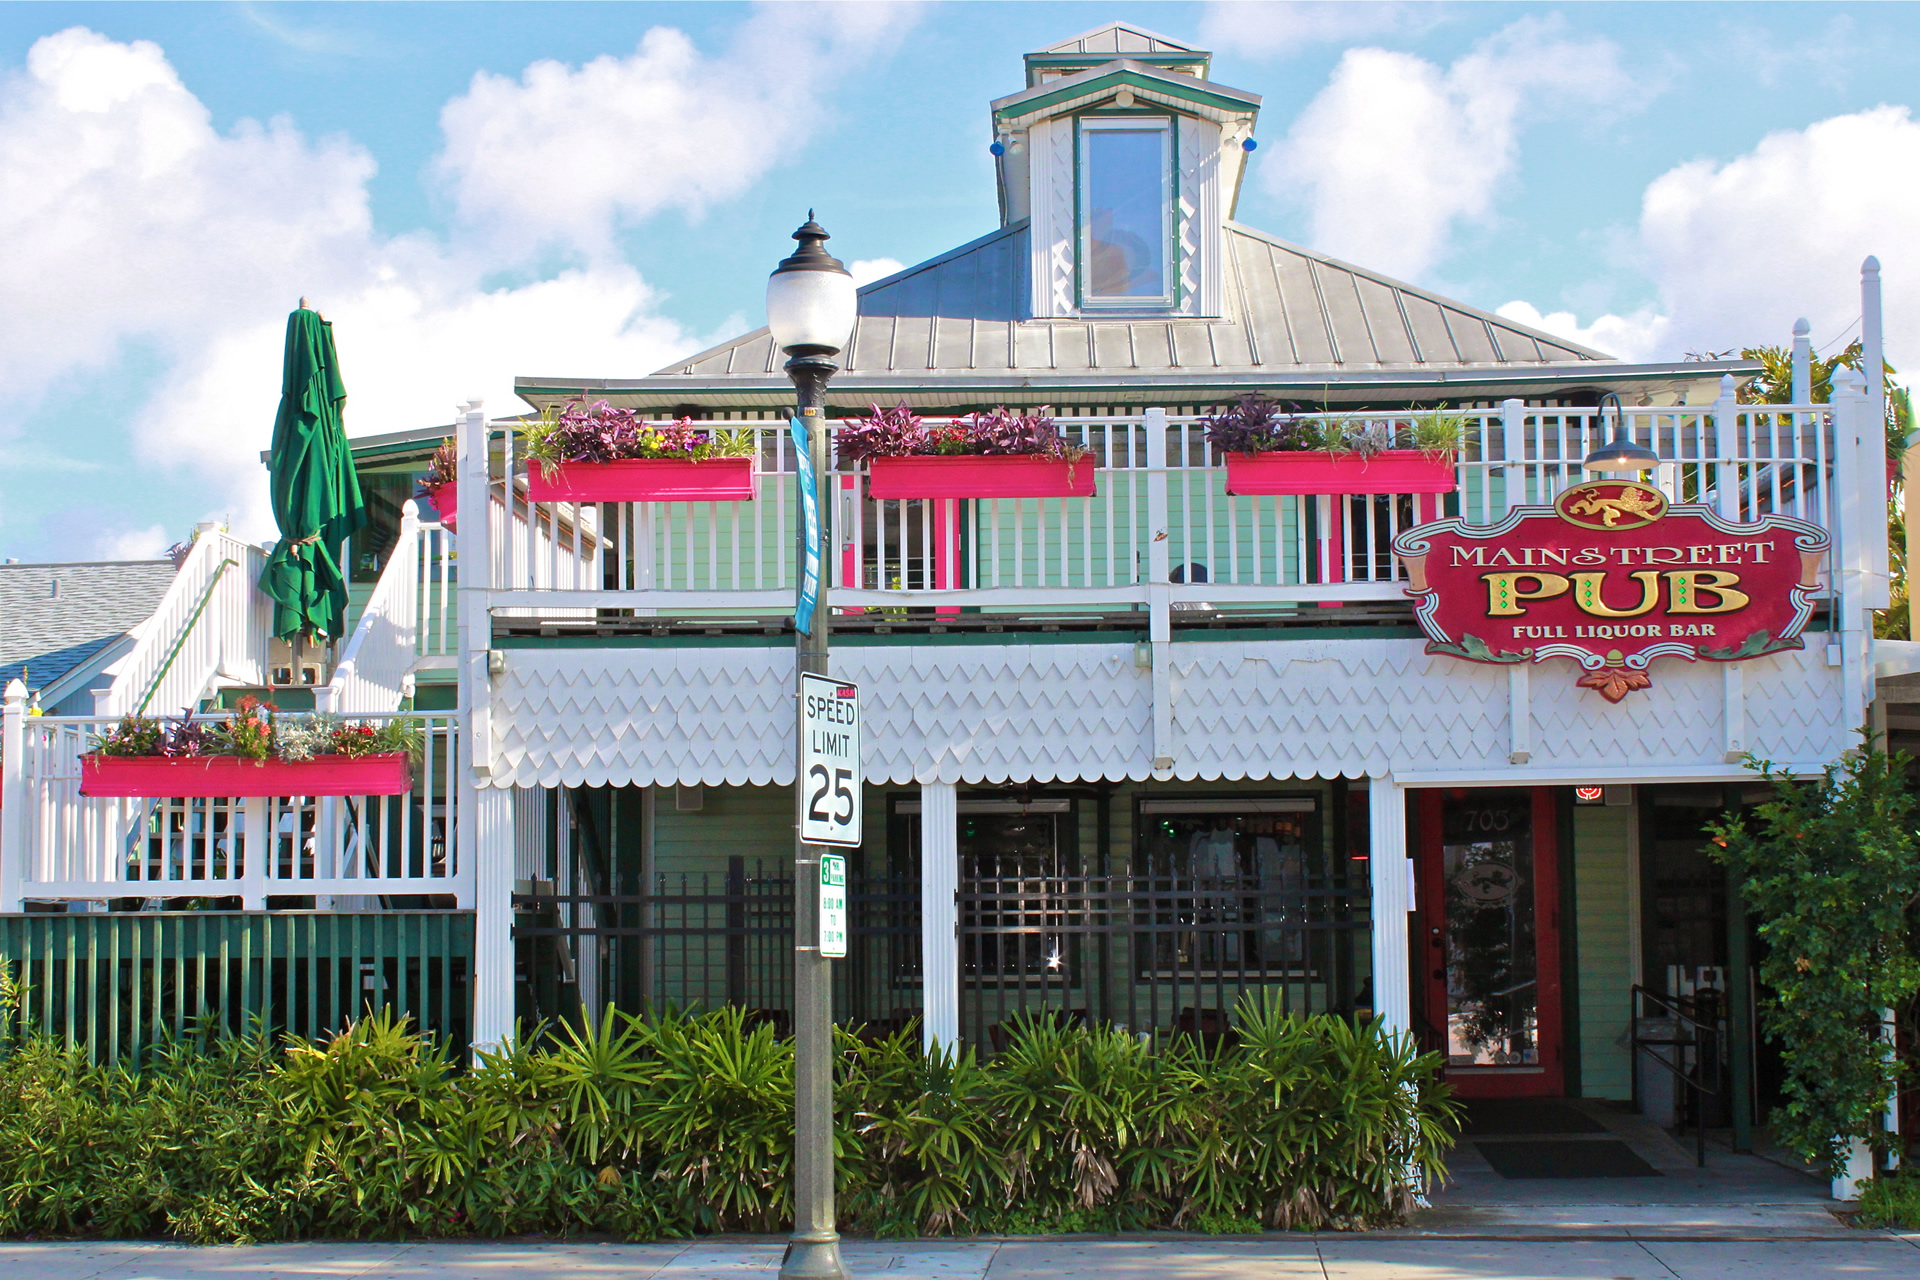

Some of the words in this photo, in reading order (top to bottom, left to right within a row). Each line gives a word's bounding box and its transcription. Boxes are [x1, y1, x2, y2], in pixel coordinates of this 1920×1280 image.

[1481, 570, 1750, 618] PUB
[1512, 625, 1568, 639] FULL
[1575, 625, 1662, 640] LIQUOR
[1669, 623, 1716, 637] BAR
[807, 695, 855, 726] SPEED
[813, 729, 850, 758] LIMIT
[808, 763, 854, 826] 25
[1465, 810, 1509, 831] 705
[823, 860, 830, 883] 3
[836, 898, 843, 910] AM
[830, 914, 836, 926] TO
[836, 931, 843, 943] PM
